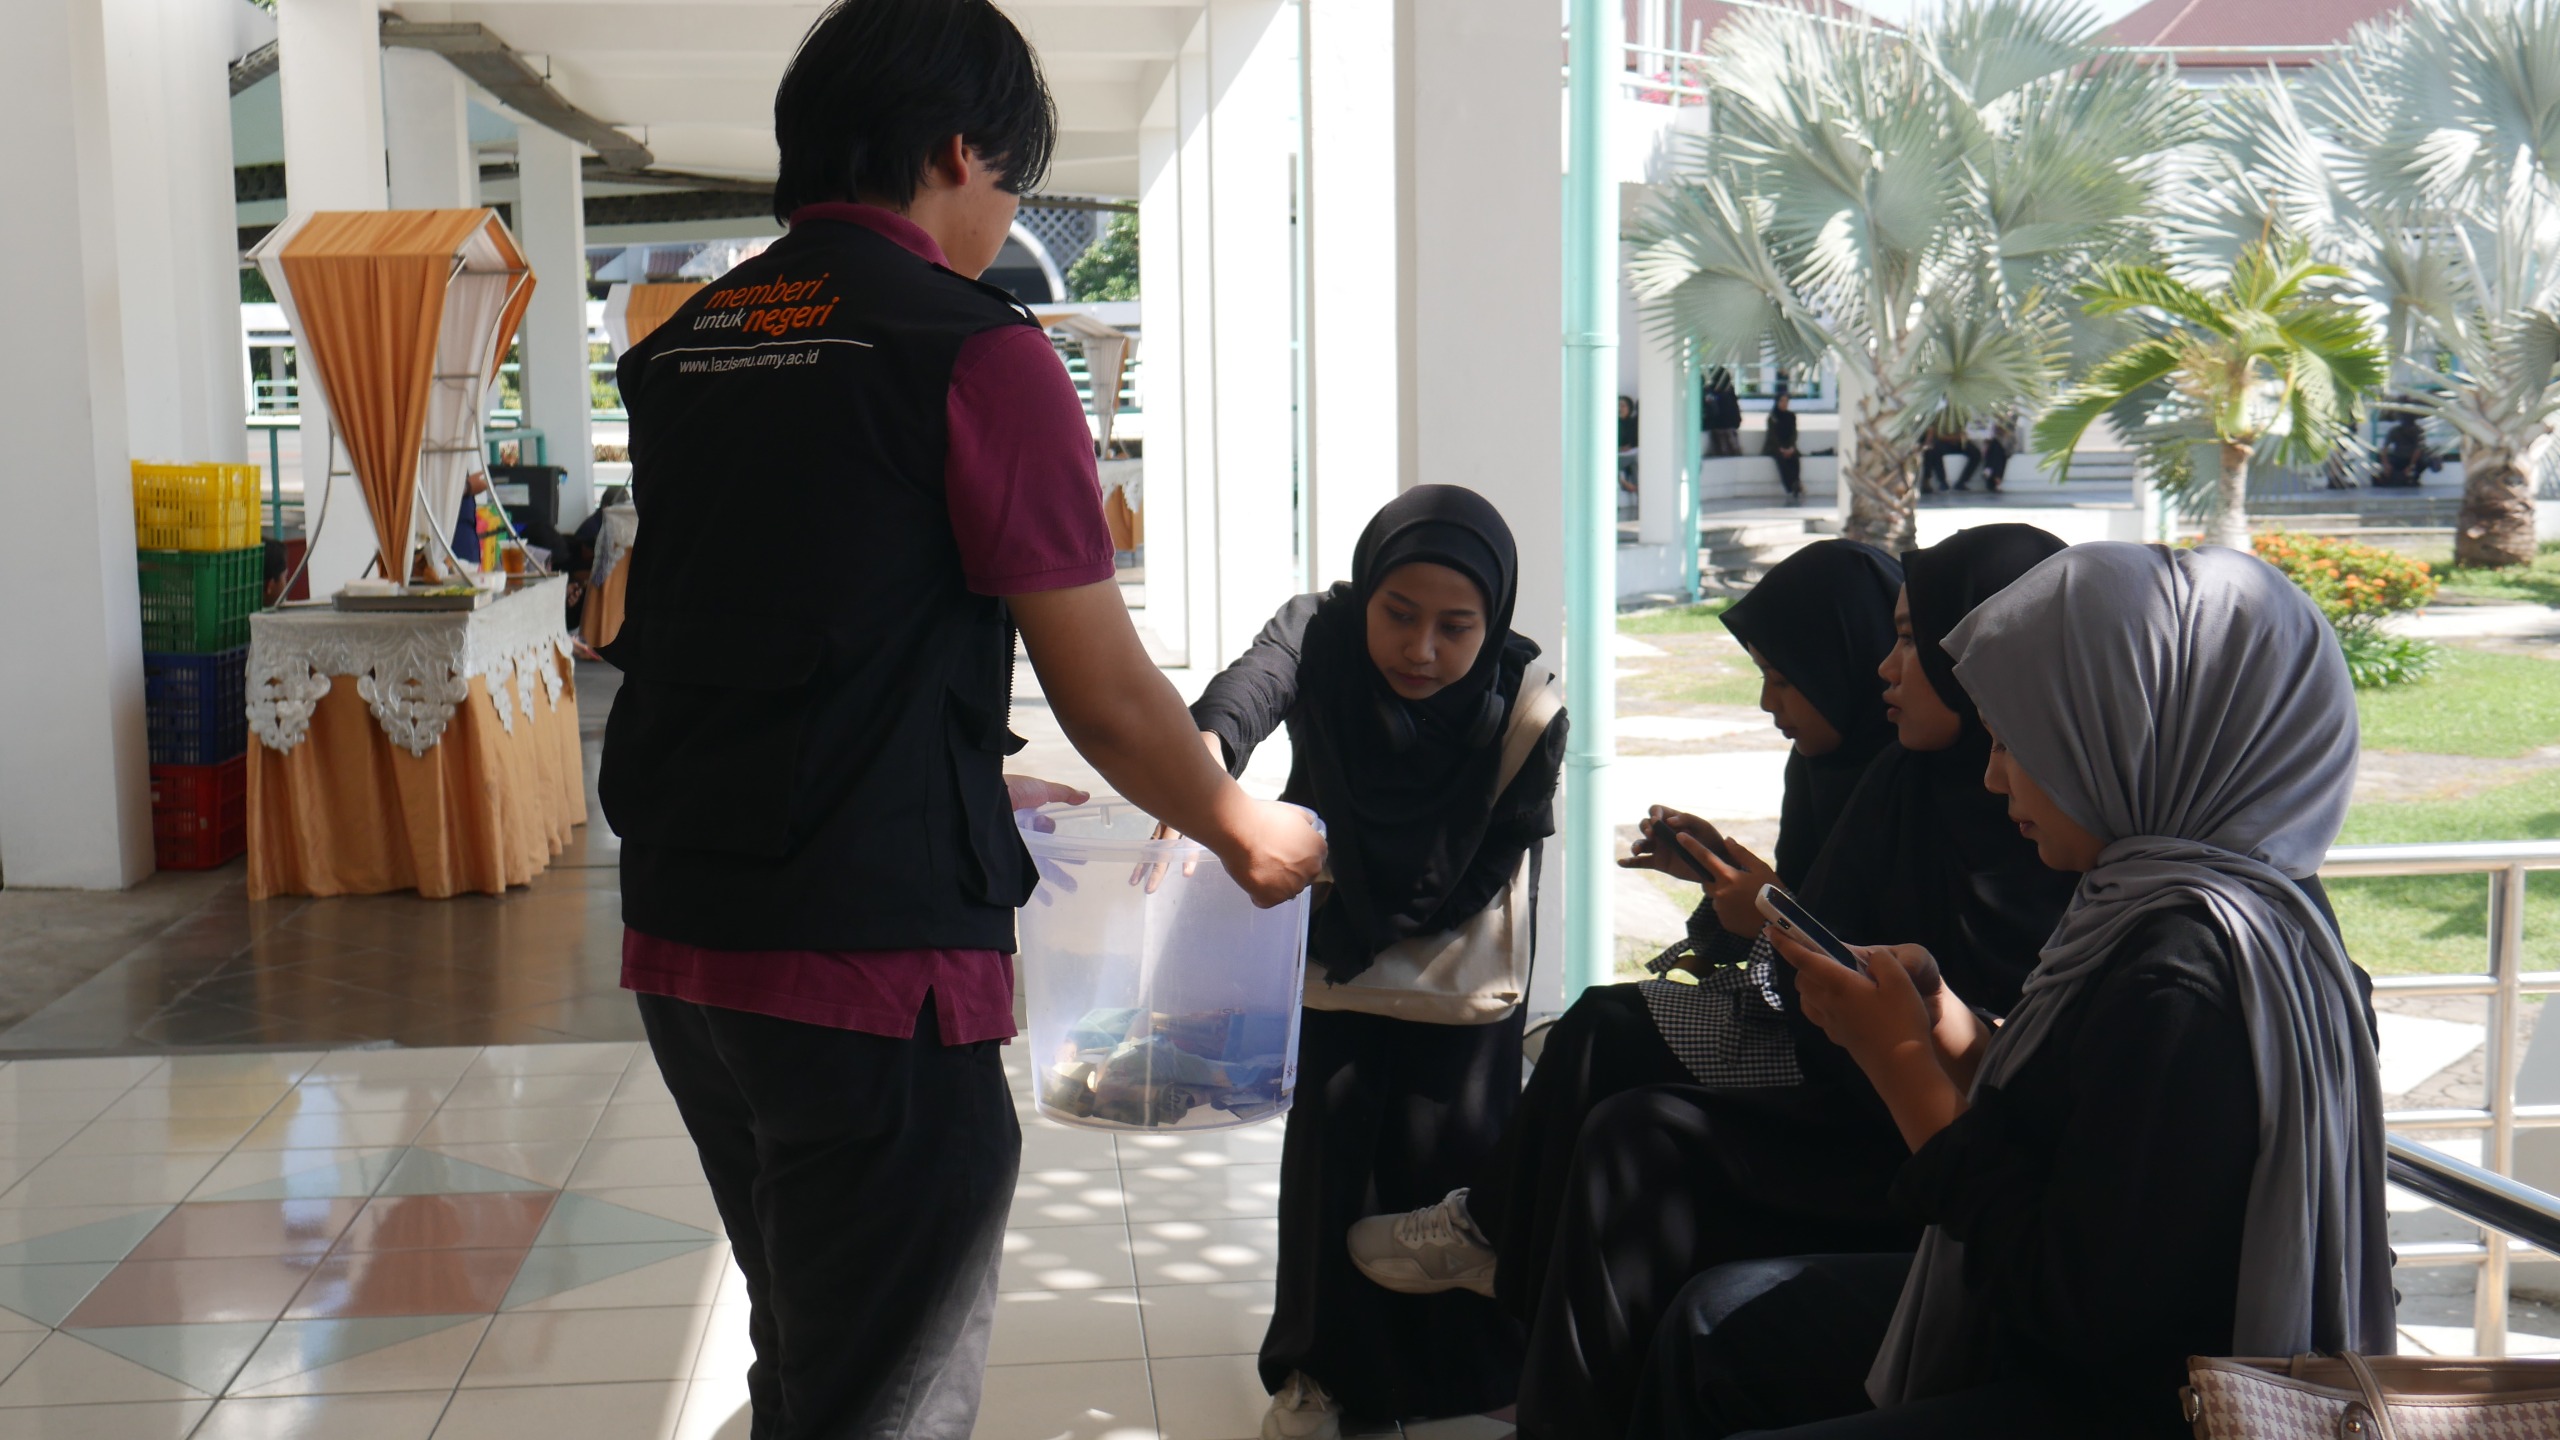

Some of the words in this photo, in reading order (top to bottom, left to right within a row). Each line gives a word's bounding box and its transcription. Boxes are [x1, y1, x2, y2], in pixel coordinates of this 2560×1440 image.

[704, 273, 829, 309] memberi
[693, 308, 746, 330] untuk
[742, 296, 839, 337] negeri
[679, 349, 820, 373] www.lazismu.umy.ac.id
